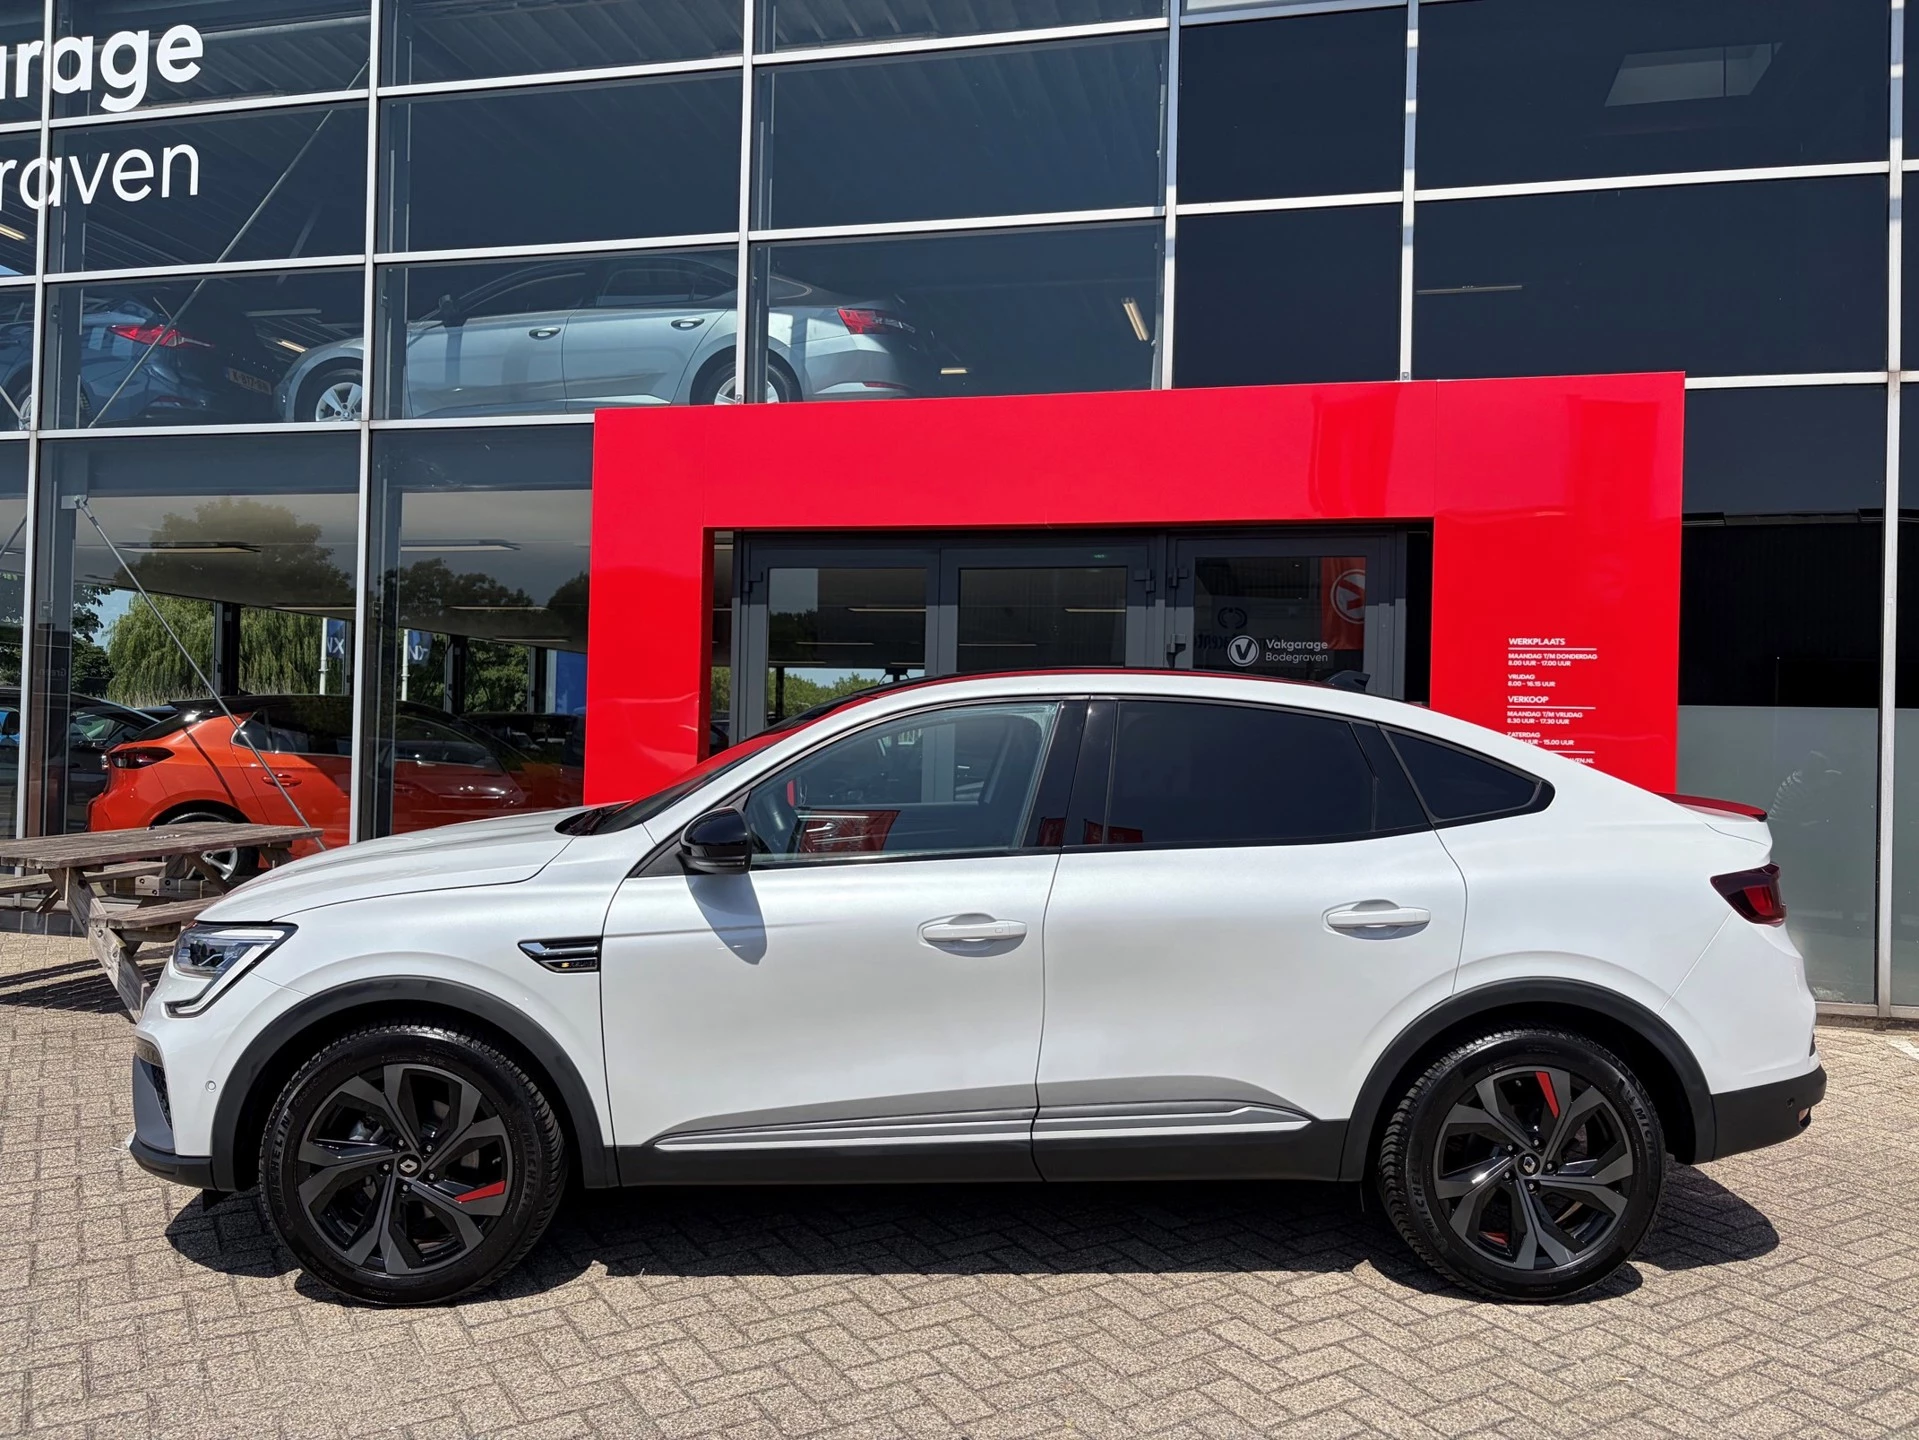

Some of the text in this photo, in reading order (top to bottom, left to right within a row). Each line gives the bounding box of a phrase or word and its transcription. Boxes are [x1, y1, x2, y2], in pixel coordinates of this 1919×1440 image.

[1266, 639, 1328, 652] Vakgarage
[1508, 637, 1566, 646] WERKPLAATS
[1265, 651, 1328, 664] Bodegraven
[1507, 695, 1549, 703] VERKOOP
